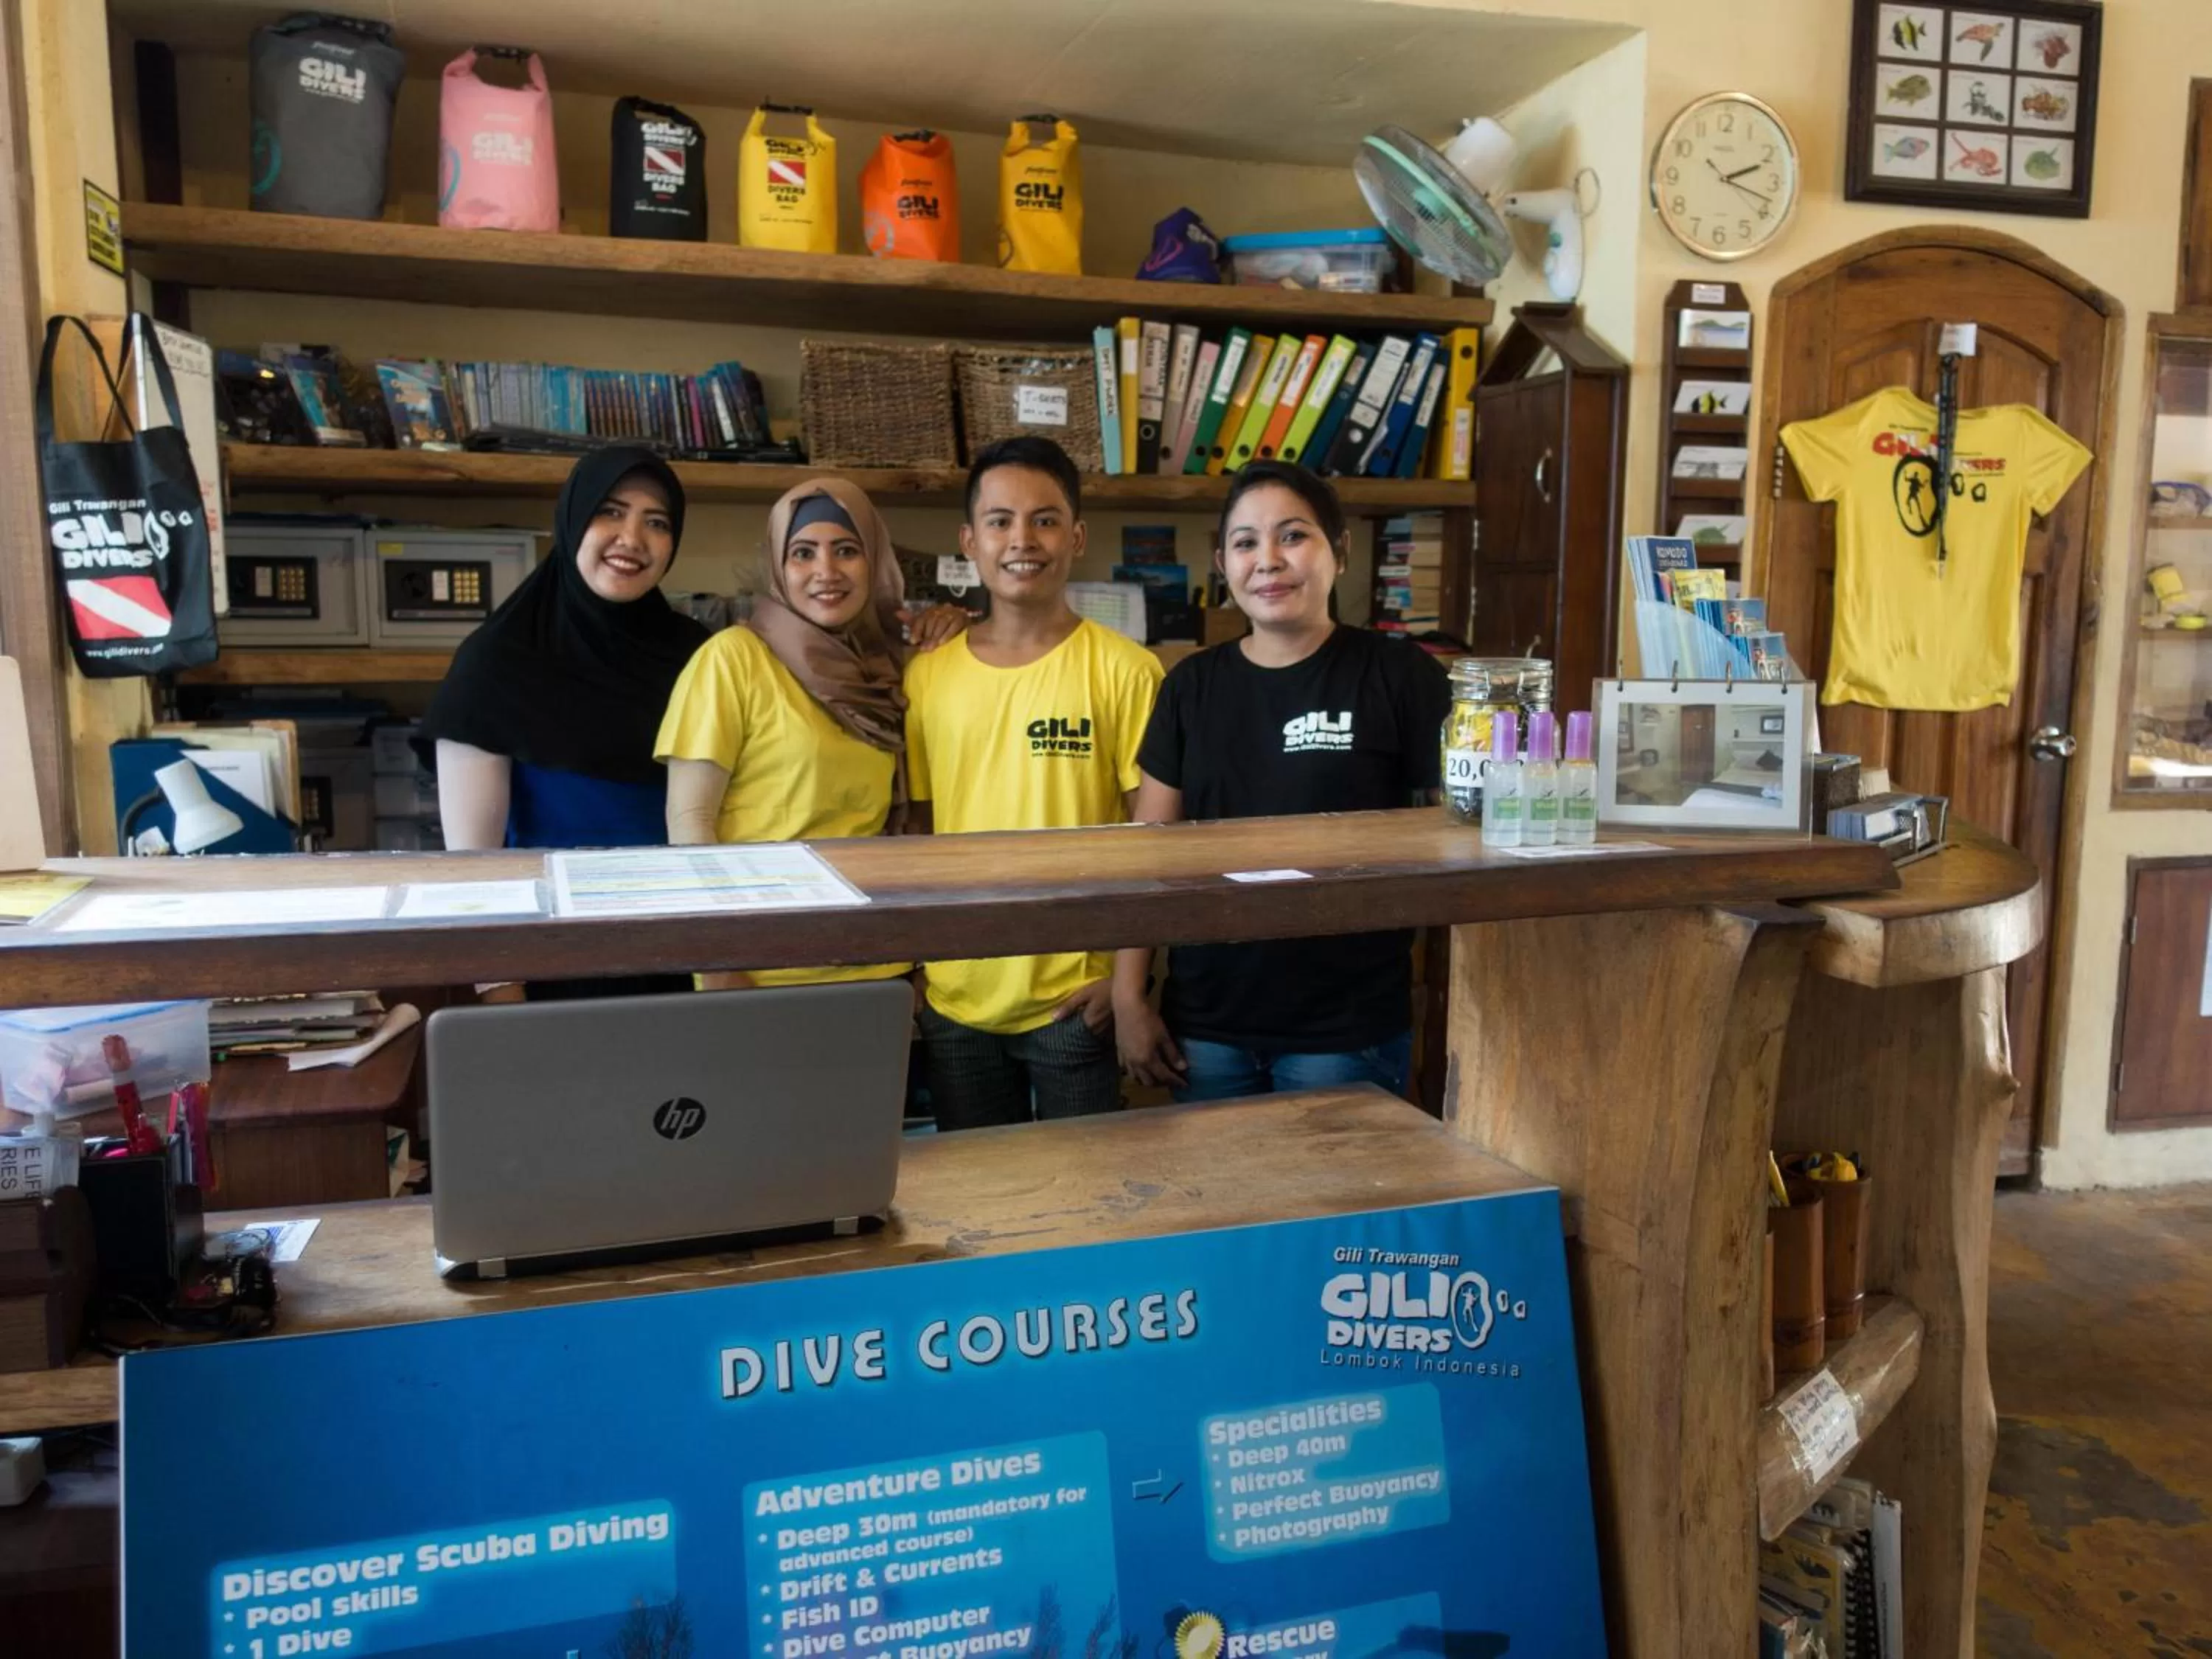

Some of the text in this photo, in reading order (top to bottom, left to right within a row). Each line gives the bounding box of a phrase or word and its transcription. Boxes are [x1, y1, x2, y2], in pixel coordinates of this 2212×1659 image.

[1717, 114, 1734, 133] 12
[1674, 139, 1693, 158] 10
[1761, 145, 1775, 163] 2
[1015, 183, 1064, 199] GILI
[1666, 166, 1679, 185] 9
[1767, 173, 1779, 192] 3
[897, 195, 939, 210] GILI
[1672, 195, 1686, 215] 8
[1690, 217, 1702, 237] 7
[1712, 226, 1725, 244] 6
[1738, 219, 1752, 239] 5
[52, 510, 144, 550] GILI
[1027, 717, 1091, 738] GILI
[1283, 711, 1352, 736] GILI
[1285, 731, 1354, 746] DIVERS
[1032, 740, 1093, 752] DIVERS
[661, 1096, 700, 1140] hp
[24, 1164, 42, 1197] LIF
[1333, 1247, 1460, 1268] Gili Trawangan
[1321, 1271, 1450, 1320] GILI
[720, 1288, 1199, 1399] DIVE COURSES
[1327, 1320, 1453, 1353] DIVERS
[1321, 1349, 1521, 1377] Lombok Indonesia
[1208, 1399, 1382, 1445] Specialities
[1228, 1434, 1346, 1468] Deep 40m
[756, 1453, 1042, 1516] Adventure Dives
[1230, 1468, 1307, 1495] Nitrox
[1232, 1470, 1440, 1521] Perfect Buoyancy
[778, 1487, 1087, 1550] Deep 30m (mandatory for
[1235, 1505, 1389, 1548] Photography
[223, 1513, 668, 1602] Discover Scuba Diving
[779, 1526, 973, 1573] advanced course)
[781, 1547, 1003, 1601] Drift & Currents
[246, 1585, 420, 1630] Pool skills
[782, 1596, 879, 1630] Fish ID
[248, 1627, 353, 1659] 1 Dive
[784, 1606, 991, 1658] Dive Computer
[900, 1627, 1031, 1659] Buoyancy
[1227, 1620, 1335, 1658] Rescue
